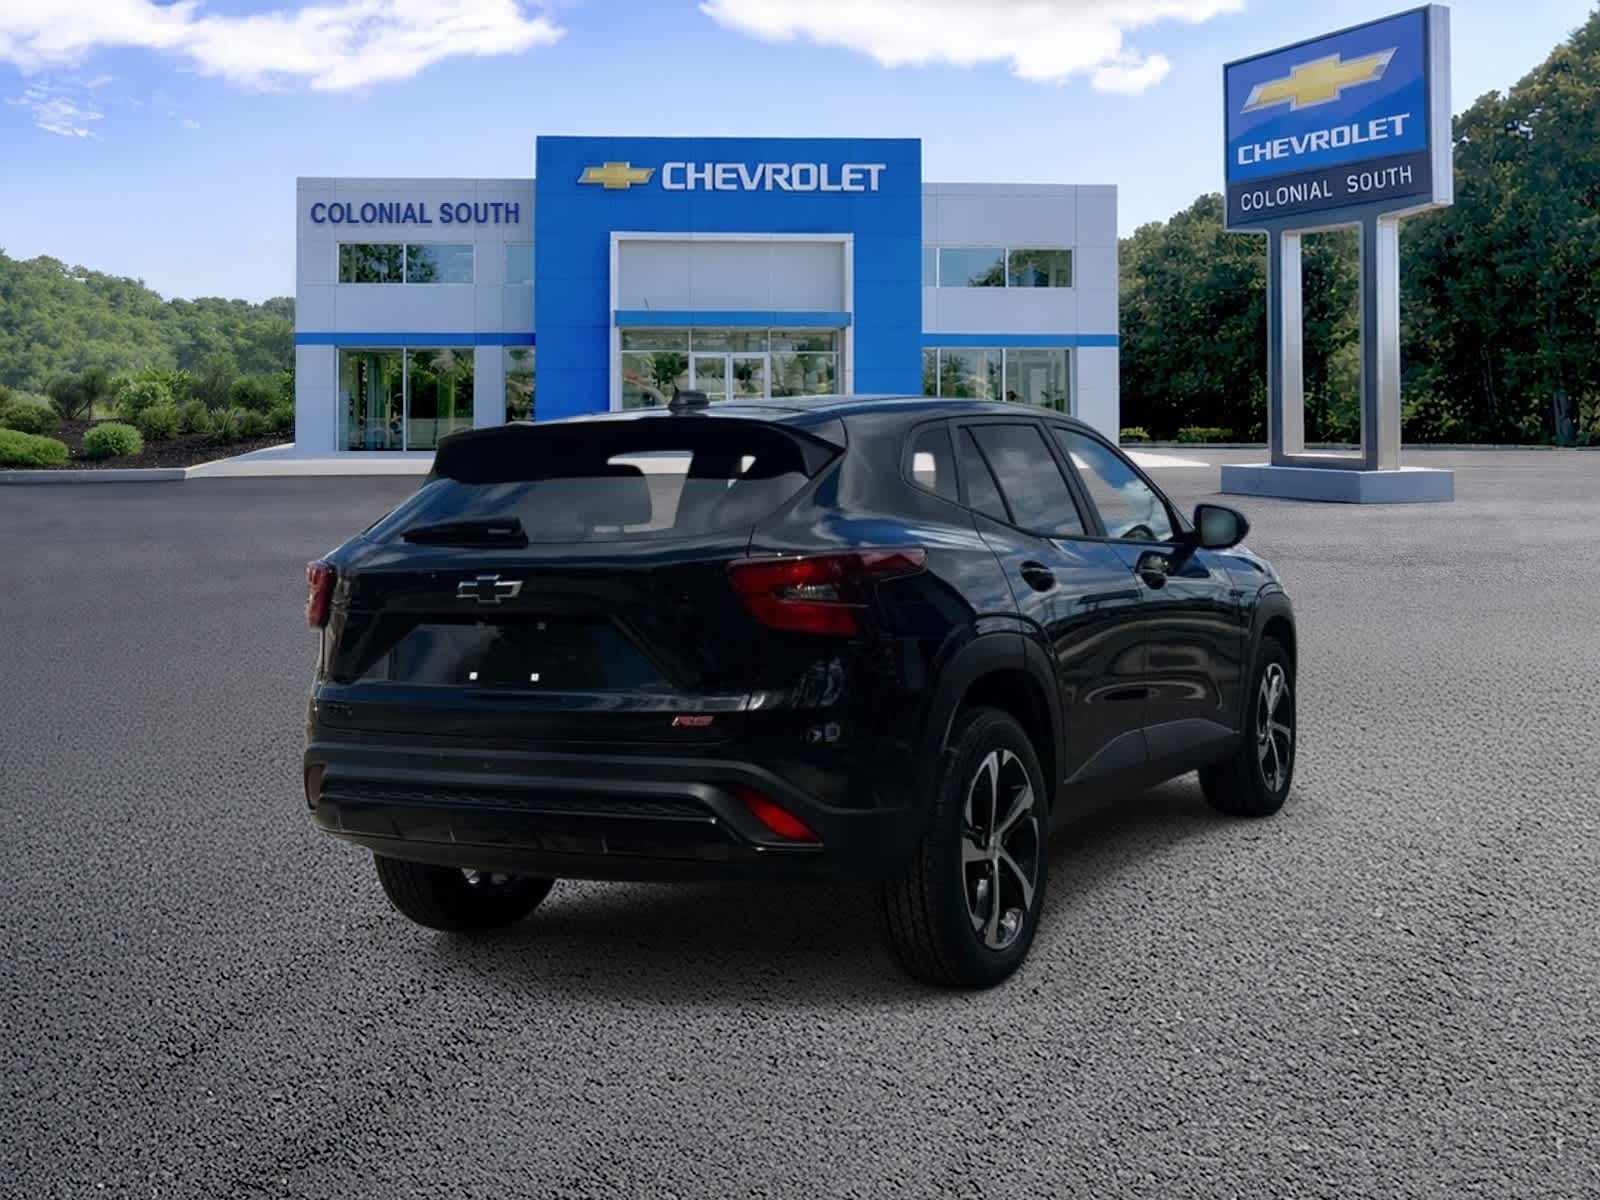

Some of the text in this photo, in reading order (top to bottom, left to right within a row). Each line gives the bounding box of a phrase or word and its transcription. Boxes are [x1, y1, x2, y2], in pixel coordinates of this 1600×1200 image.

[1237, 113, 1410, 166] CHEVROLET
[661, 161, 887, 192] CHEVROLET
[1240, 165, 1413, 211] COLONIAL SOUTH
[310, 202, 520, 224] COLONIAL SOUTH
